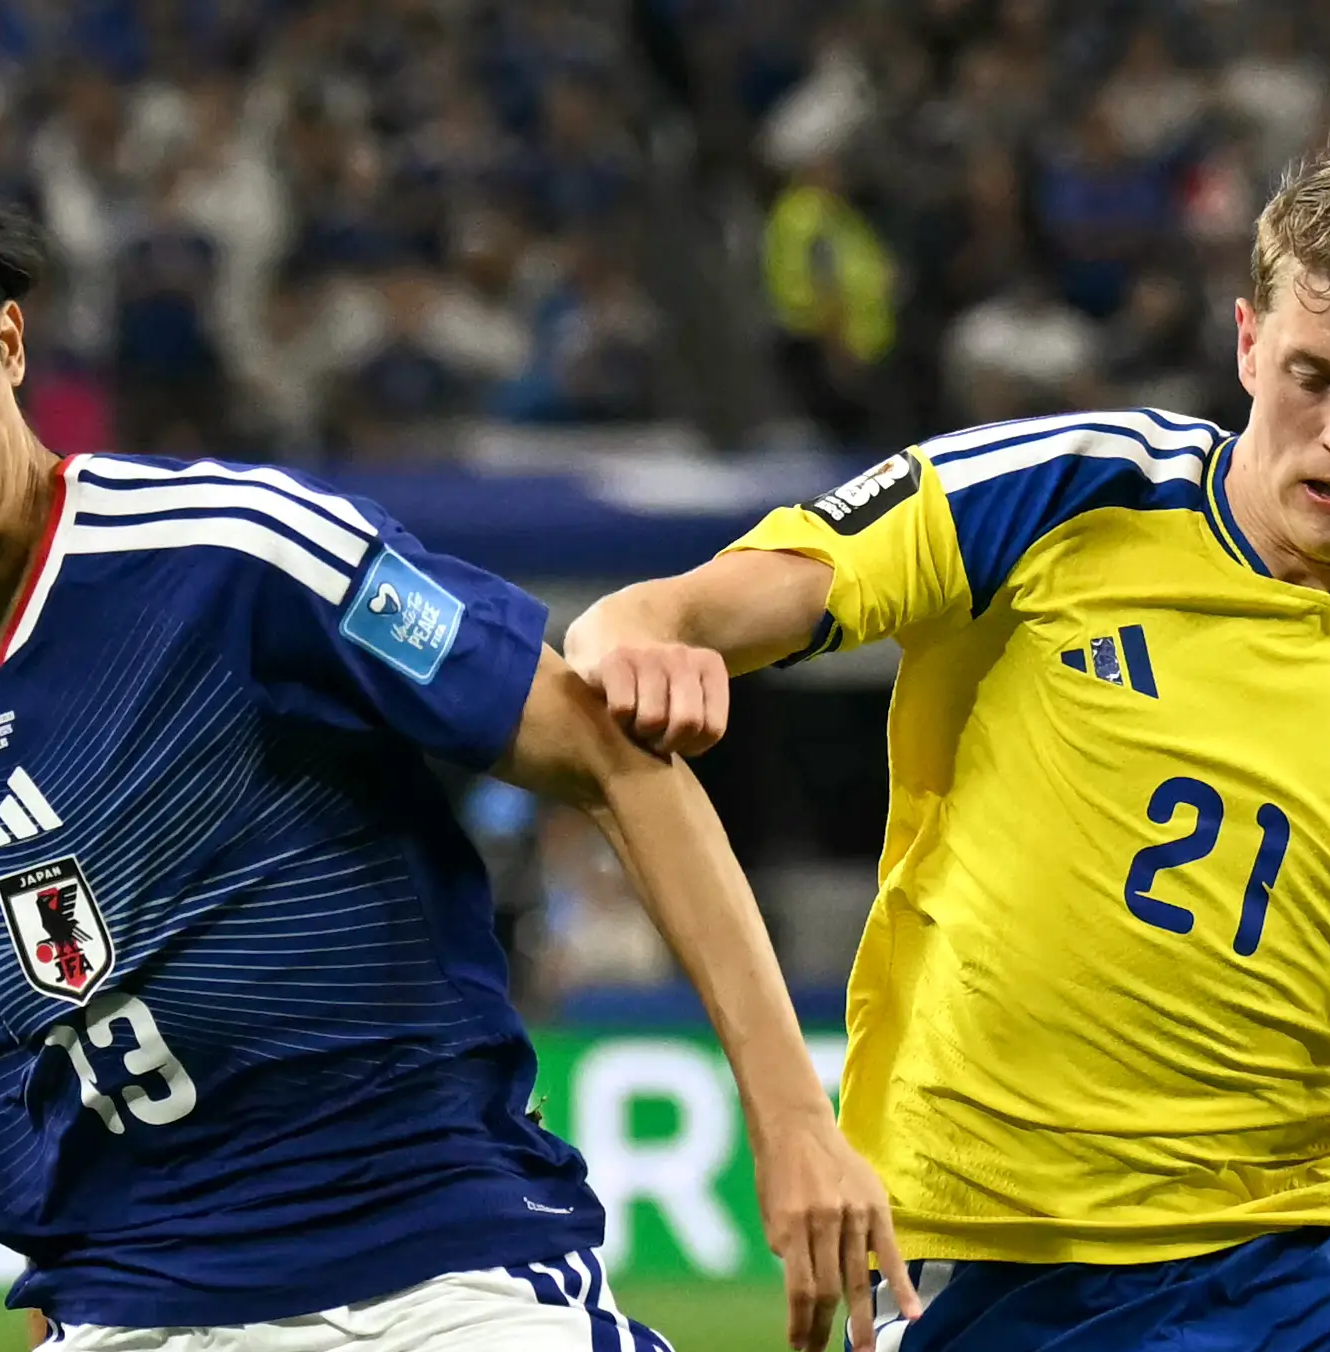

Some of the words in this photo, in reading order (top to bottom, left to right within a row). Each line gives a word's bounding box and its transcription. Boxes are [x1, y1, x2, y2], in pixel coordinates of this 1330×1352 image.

[407, 601, 440, 650] PEACE
[19, 866, 62, 888] JAPAN
[1124, 776, 1290, 957] 21
[54, 953, 95, 983] JFA
[44, 992, 197, 1135] 13
